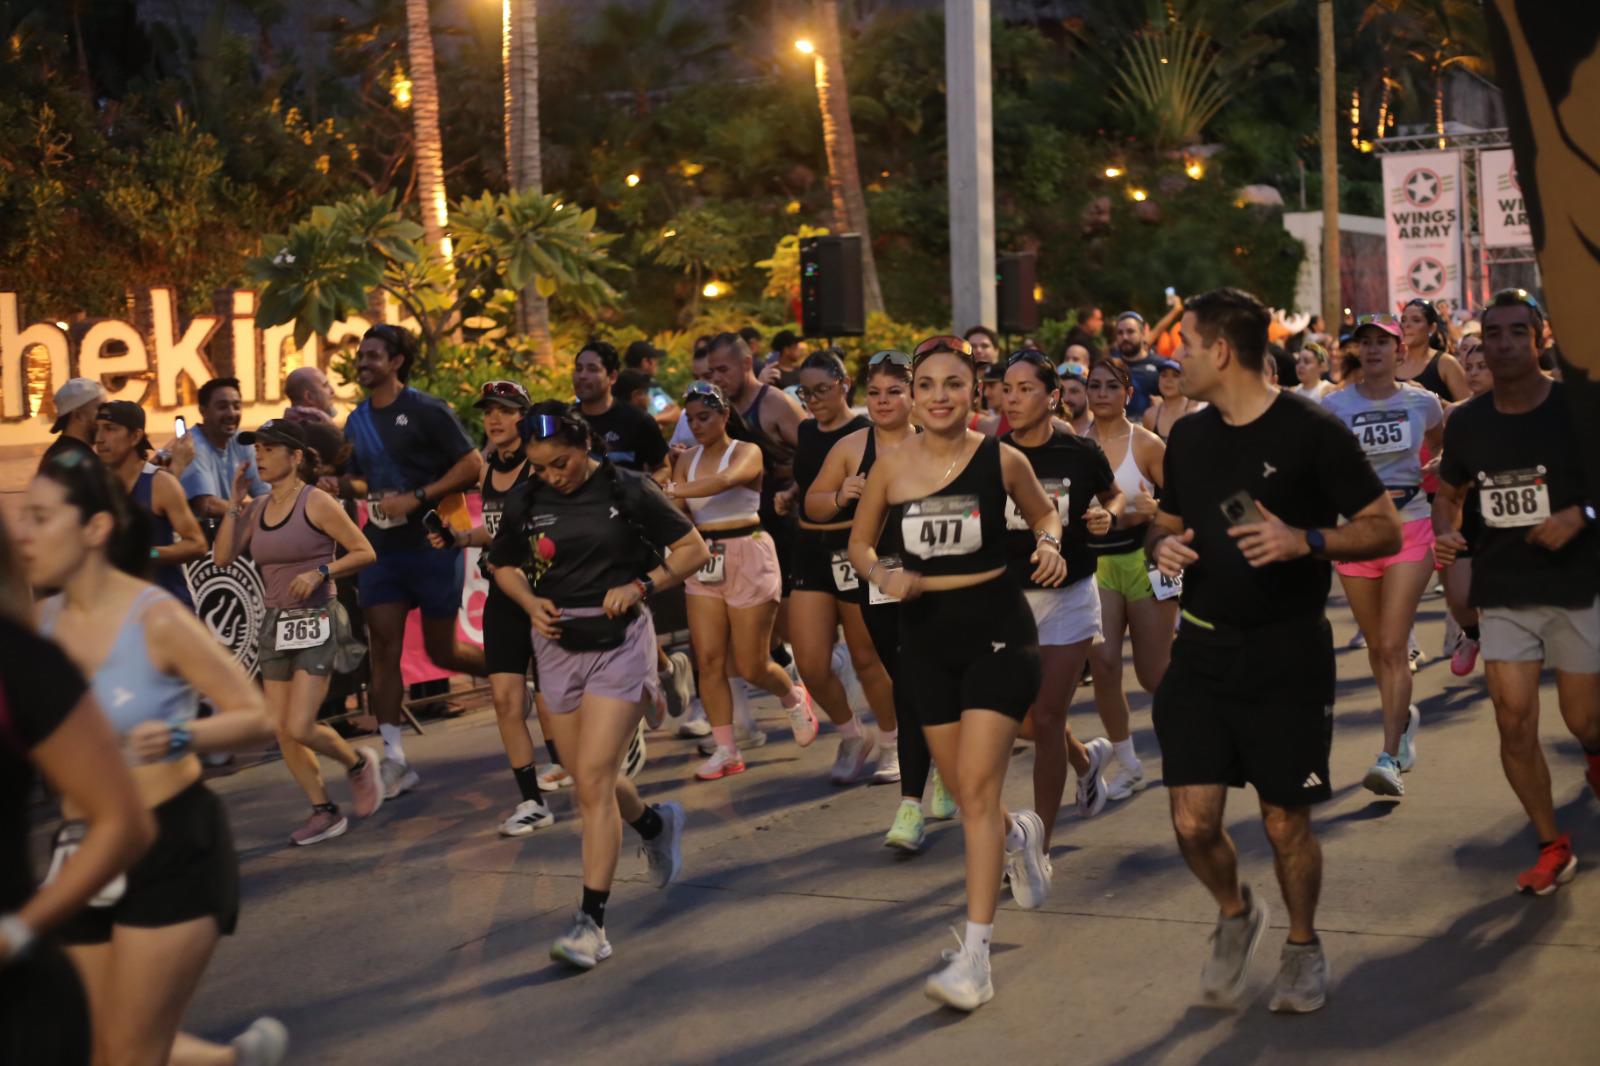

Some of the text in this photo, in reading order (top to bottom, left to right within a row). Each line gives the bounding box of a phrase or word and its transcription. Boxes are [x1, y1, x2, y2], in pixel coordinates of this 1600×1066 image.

[1399, 224, 1451, 239] ARMY
[1363, 423, 1403, 446] 435
[1490, 487, 1538, 517] 388
[919, 519, 963, 547] 477
[283, 619, 321, 641] 363
